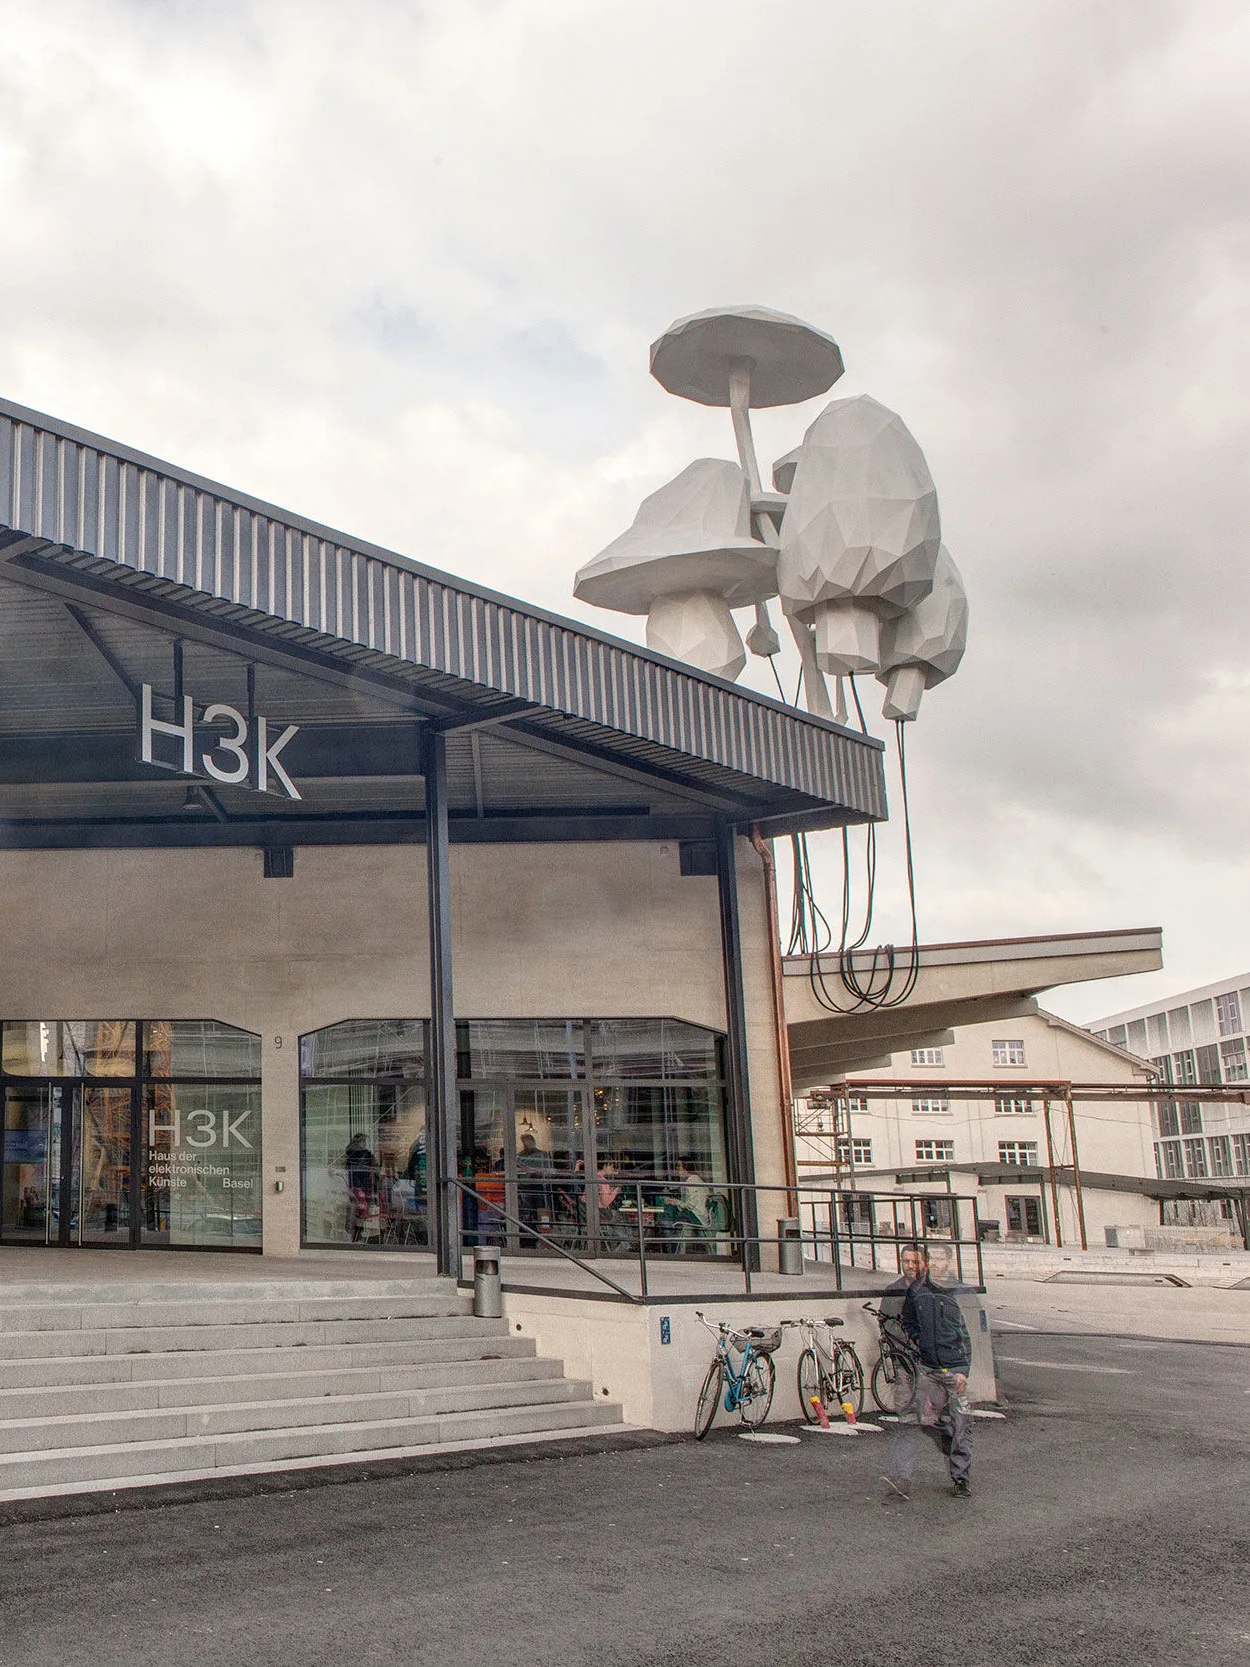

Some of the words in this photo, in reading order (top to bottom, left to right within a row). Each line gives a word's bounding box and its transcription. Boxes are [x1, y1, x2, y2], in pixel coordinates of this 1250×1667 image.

[142, 683, 302, 800] H3K
[274, 1036, 282, 1049] 9
[149, 1109, 253, 1148] H3K
[149, 1151, 176, 1161] Haus
[179, 1151, 197, 1161] der
[149, 1164, 230, 1175] elektronischen
[149, 1176, 187, 1187] Künste
[222, 1178, 253, 1189] Basel
